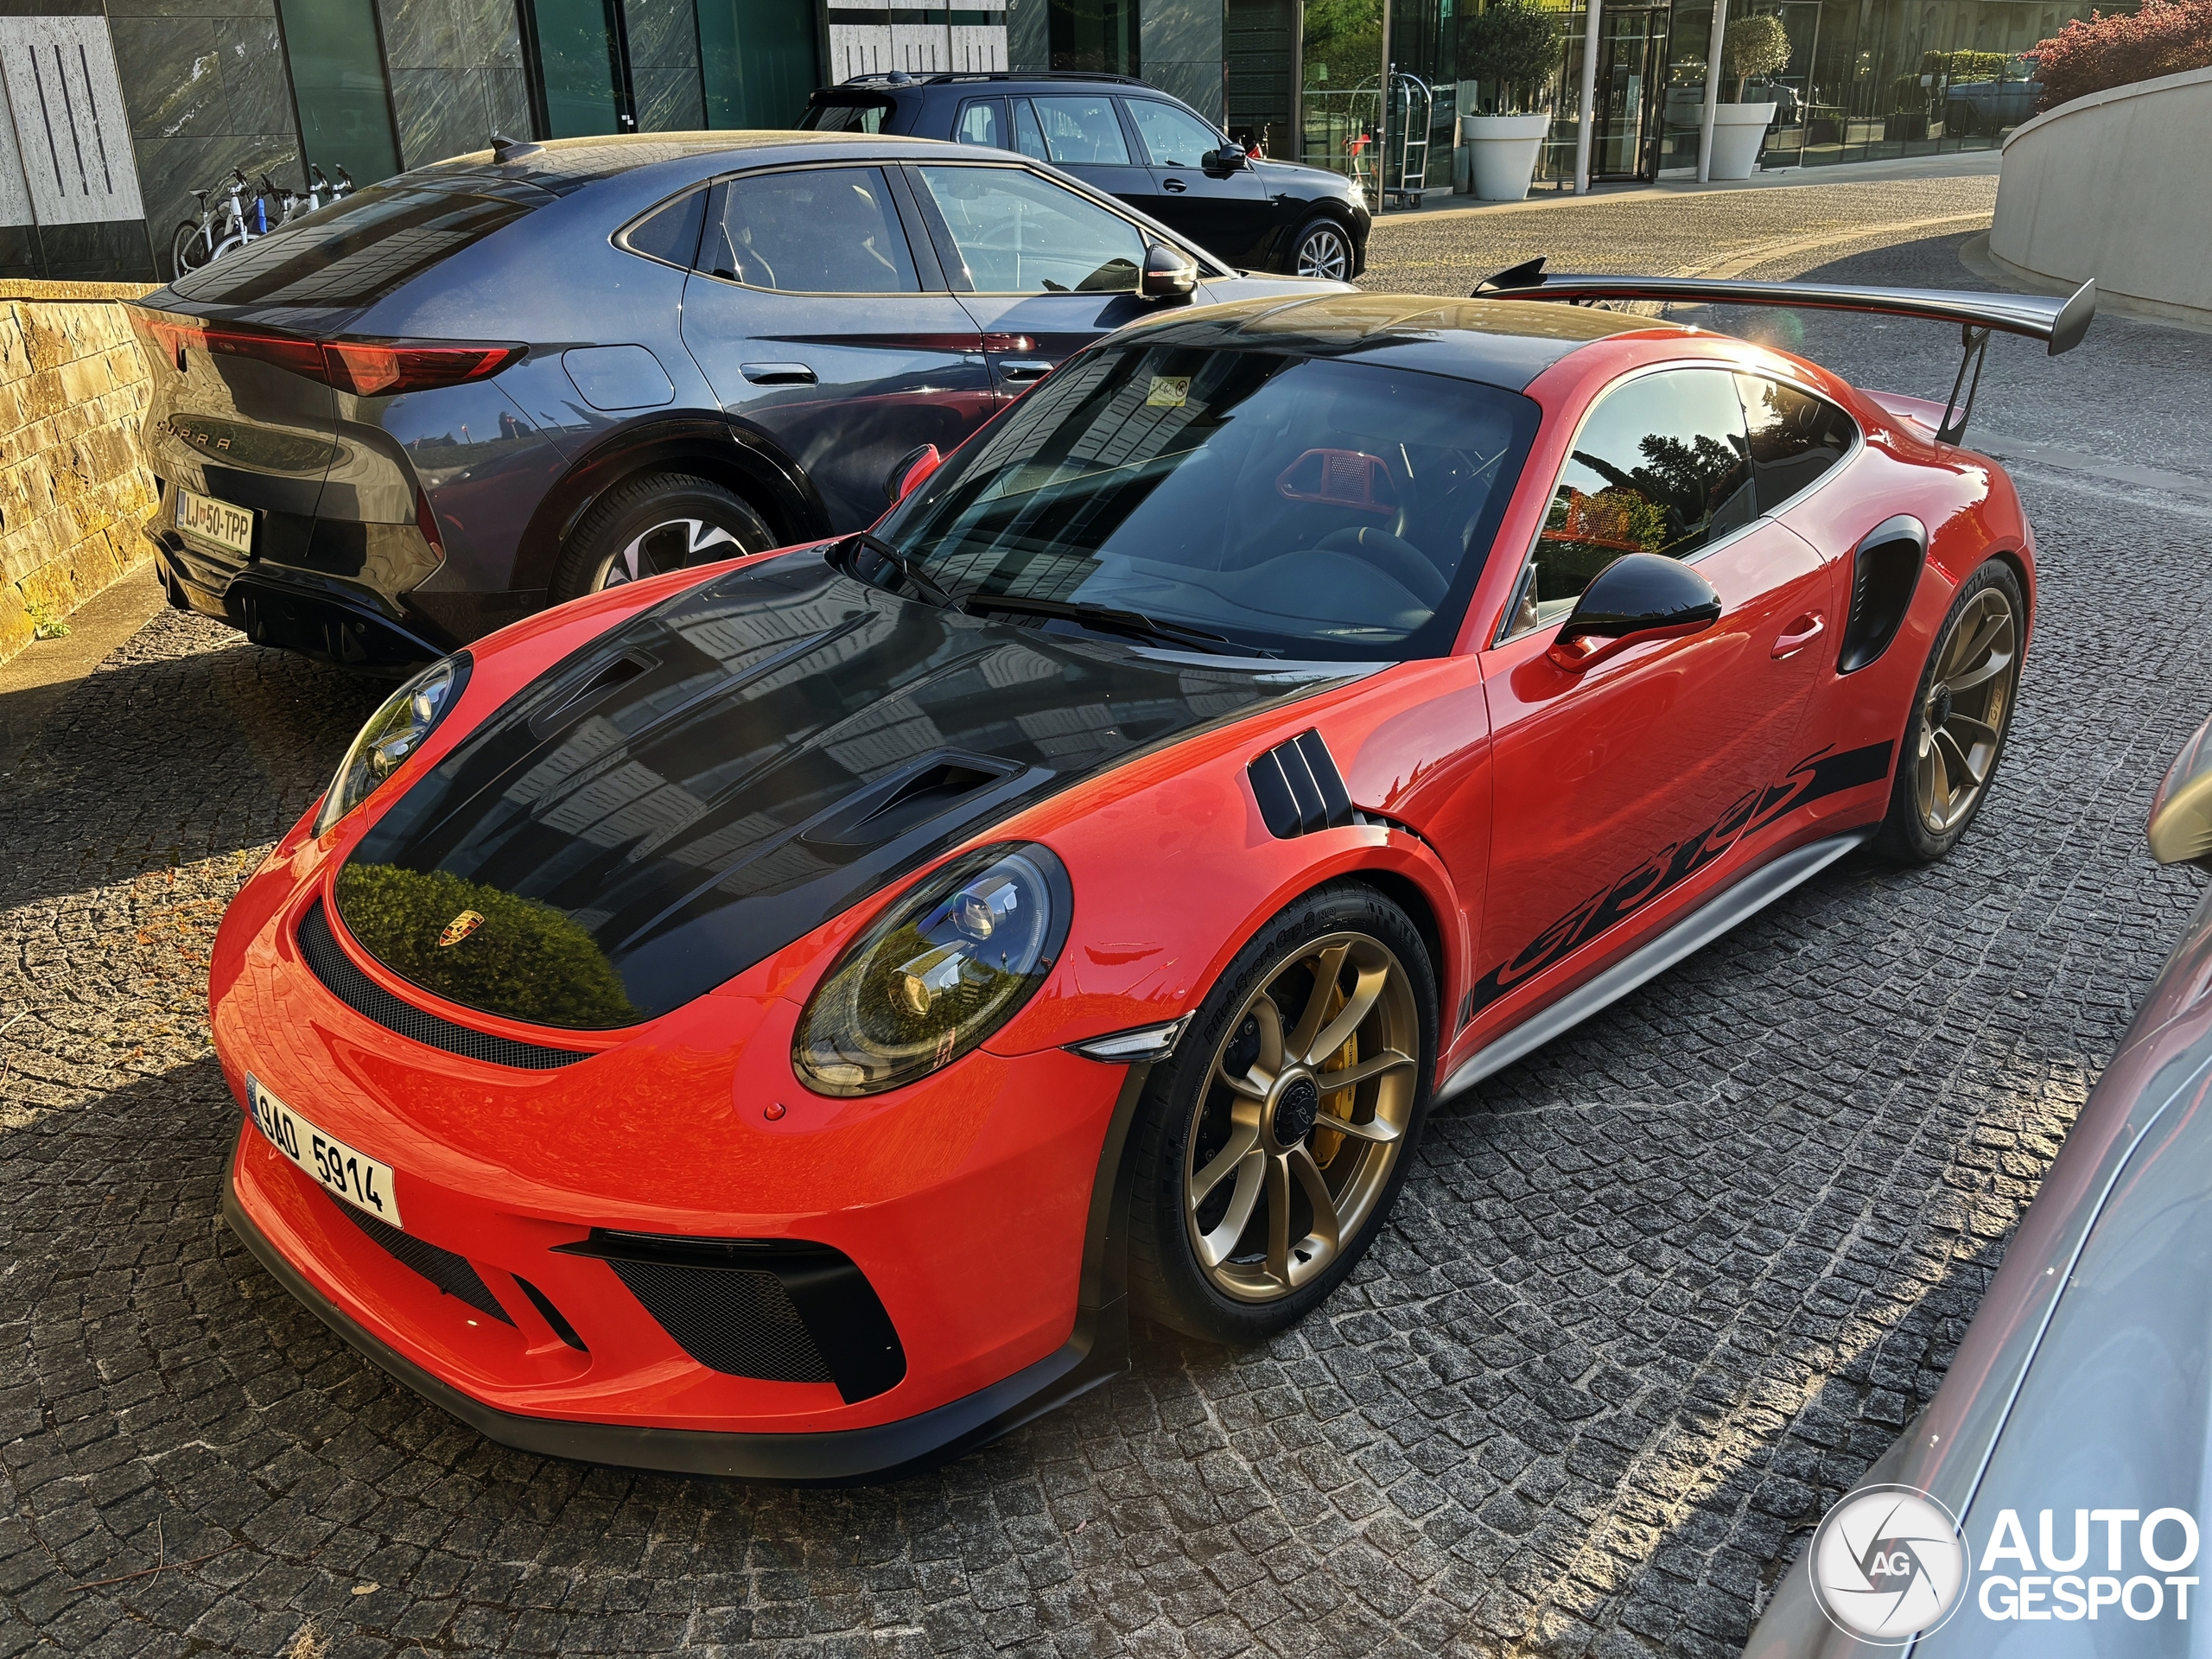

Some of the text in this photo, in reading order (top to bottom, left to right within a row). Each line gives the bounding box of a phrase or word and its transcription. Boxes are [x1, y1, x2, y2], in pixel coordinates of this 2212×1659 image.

[156, 419, 231, 449] CUPRA
[1931, 577, 1978, 664] MICHELIN
[1204, 988, 1237, 1046] Pilot
[1235, 939, 1275, 996] Sport
[1275, 921, 1303, 949] Cup
[1303, 912, 1315, 930] 2
[1296, 1106, 1312, 1124] RS
[312, 1134, 383, 1213] 5914
